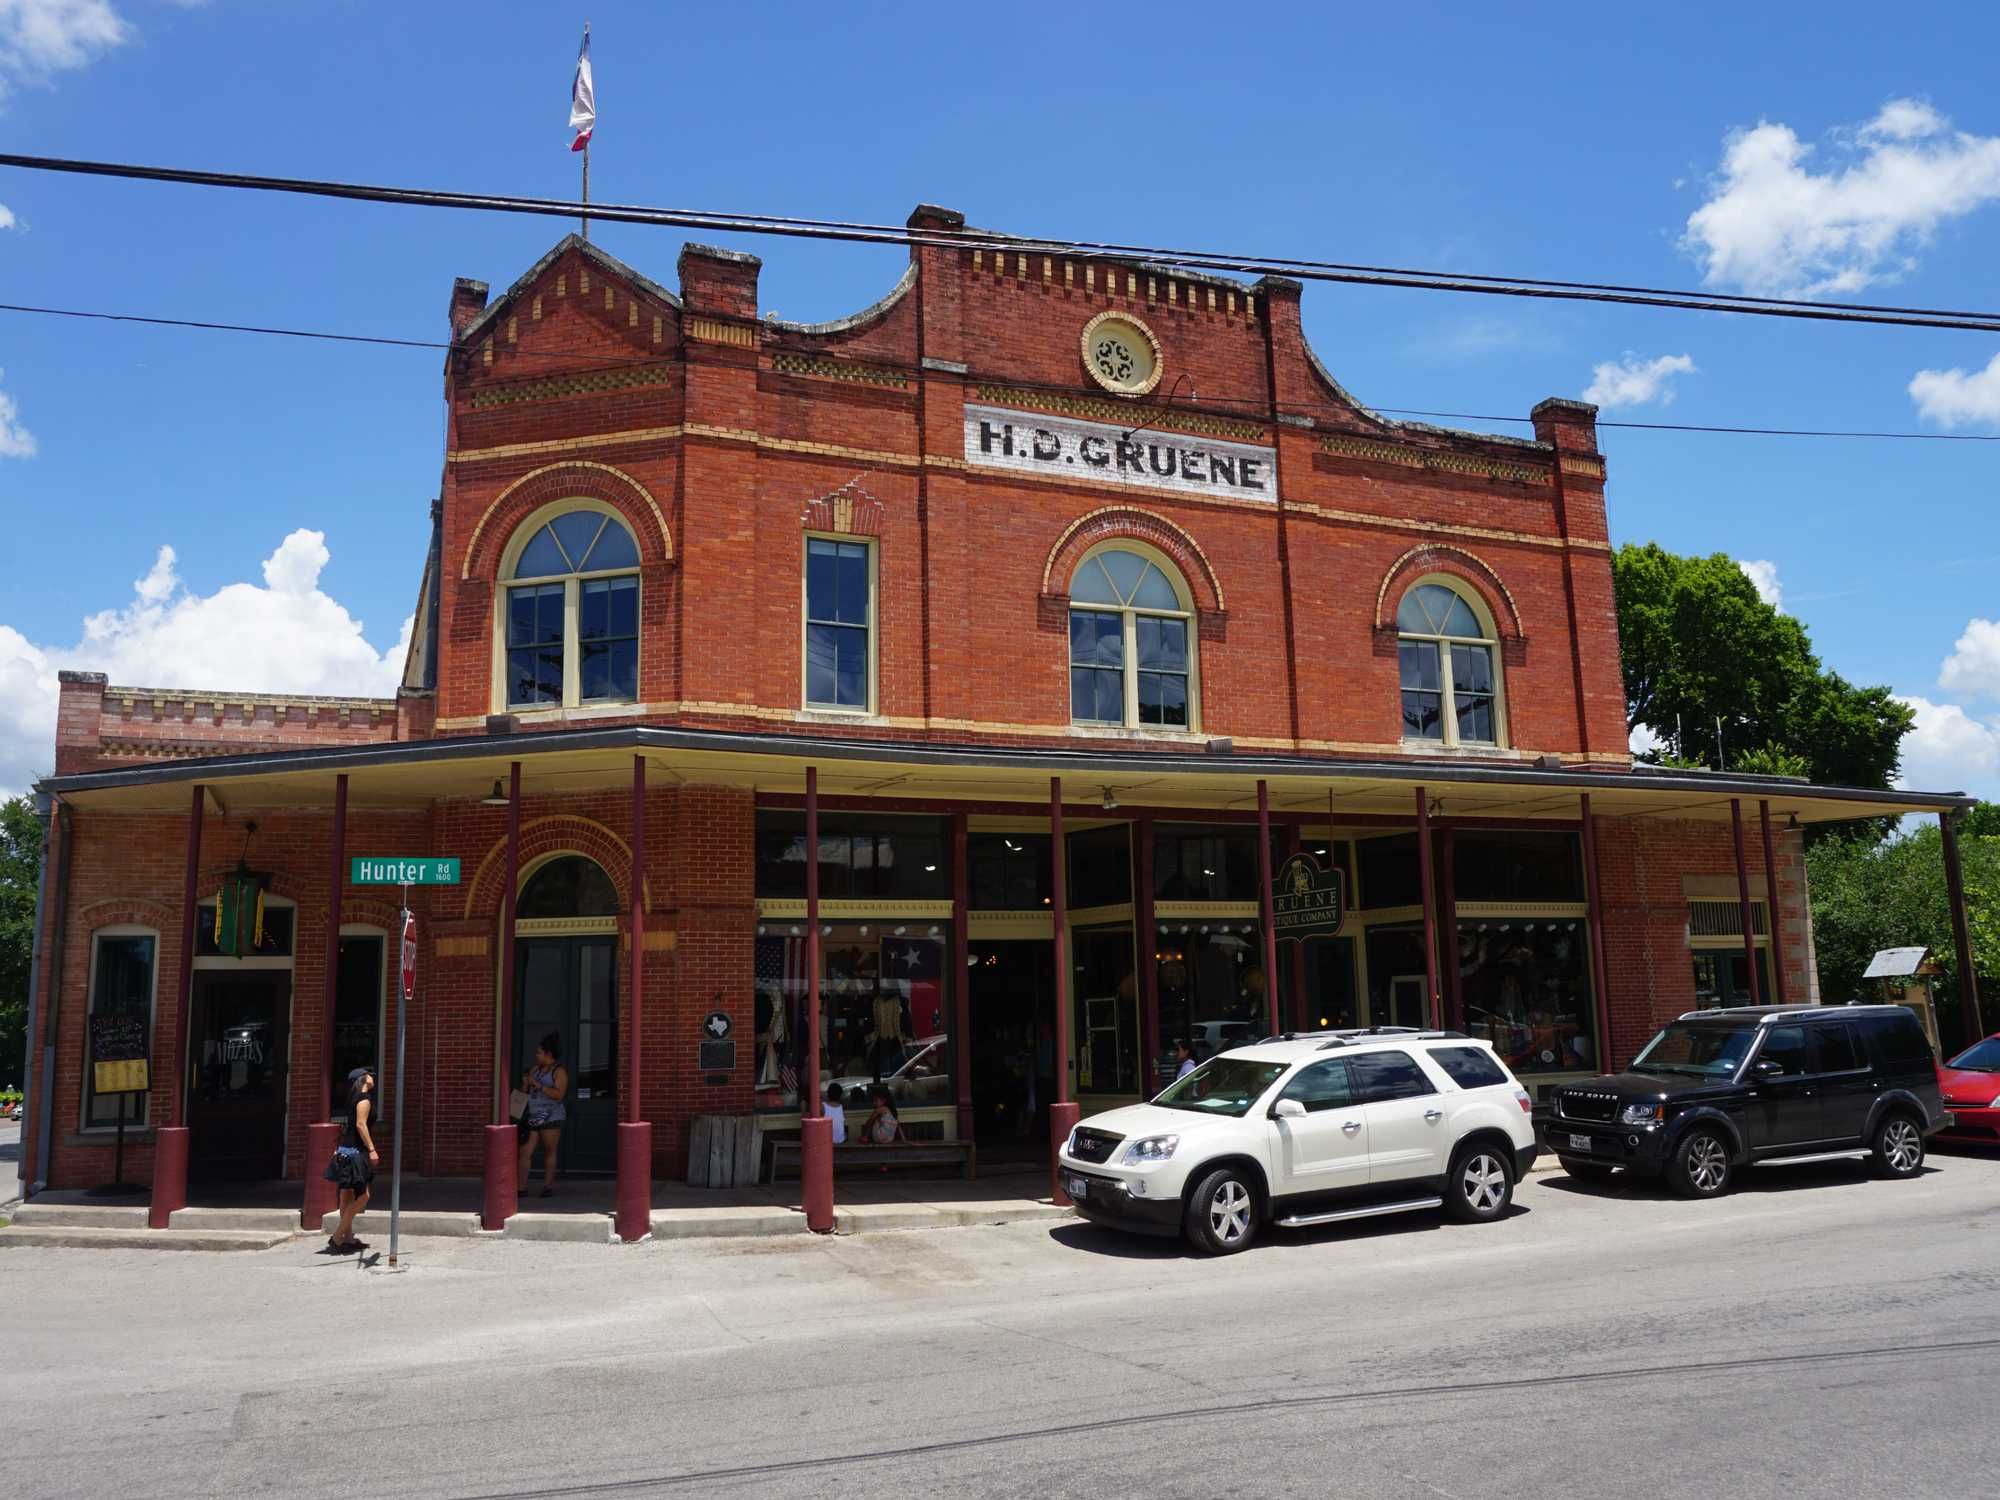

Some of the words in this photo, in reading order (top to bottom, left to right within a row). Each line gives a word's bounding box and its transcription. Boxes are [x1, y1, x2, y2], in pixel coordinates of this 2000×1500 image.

[360, 861, 427, 881] Hunter
[437, 863, 450, 874] Rd
[435, 873, 451, 881] 1600
[1277, 890, 1337, 911] RUENE
[1300, 910, 1337, 923] COMPANY
[1586, 1092, 1619, 1101] ROVER
